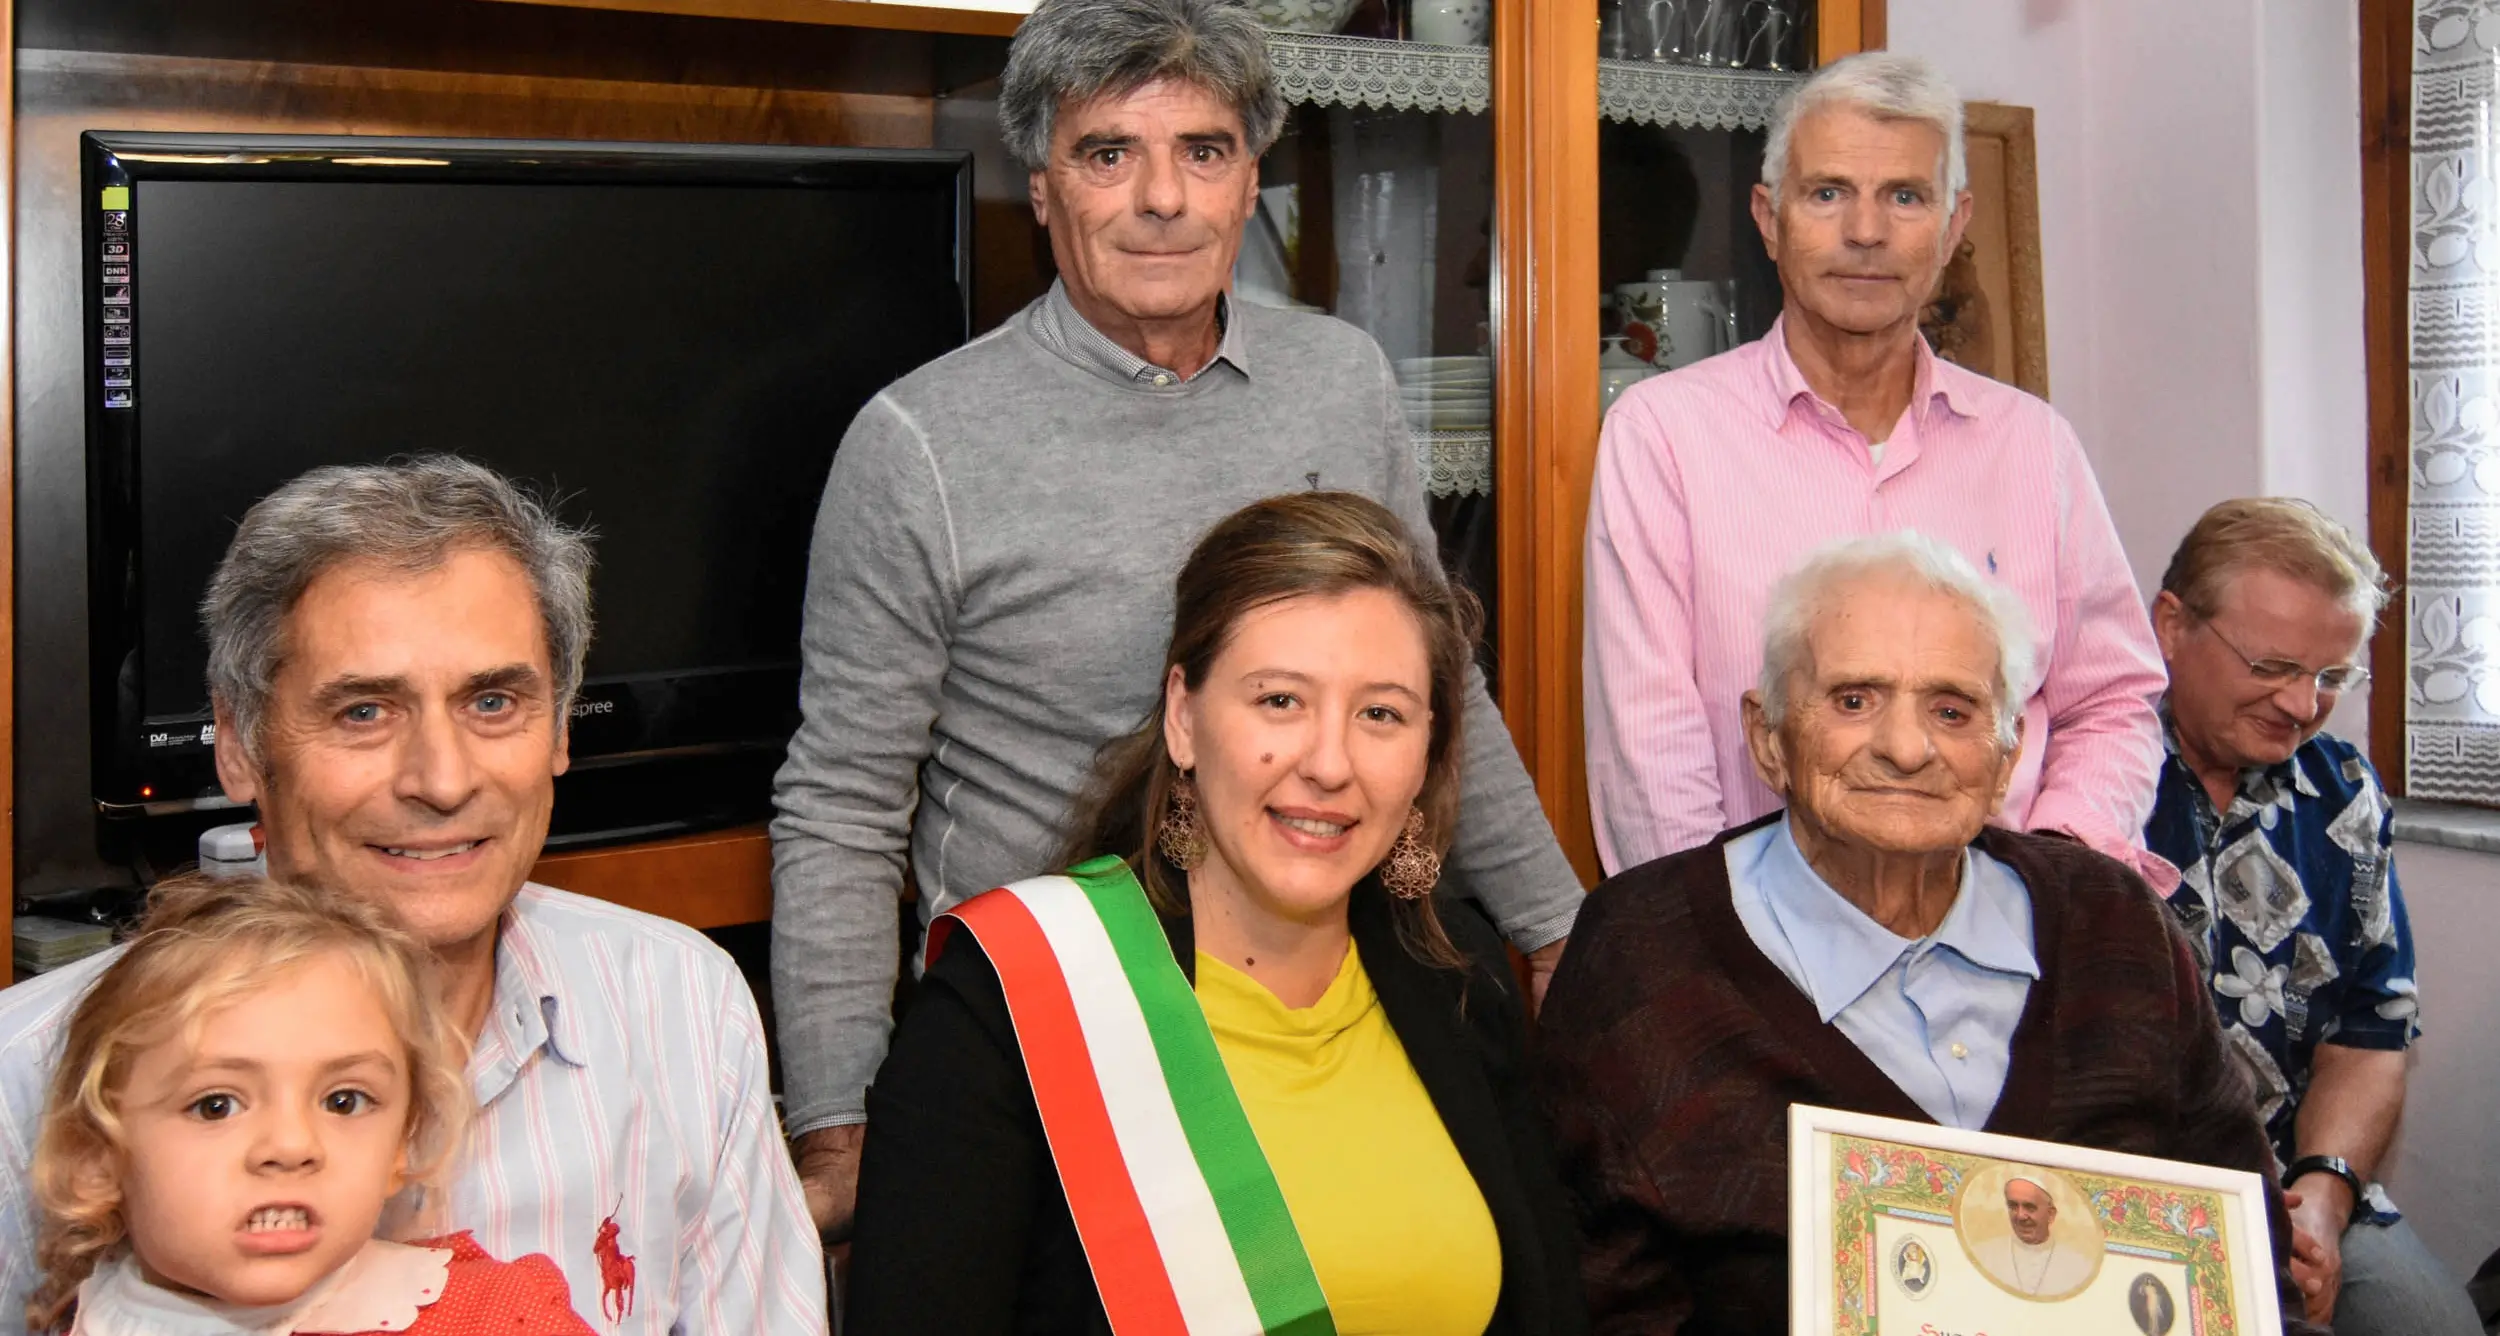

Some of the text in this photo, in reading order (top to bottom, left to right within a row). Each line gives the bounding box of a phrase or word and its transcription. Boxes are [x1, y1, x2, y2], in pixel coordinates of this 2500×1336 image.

[107, 213, 125, 227] 28
[108, 245, 124, 254] 3D
[106, 267, 127, 275] DNR
[202, 724, 216, 734] H
